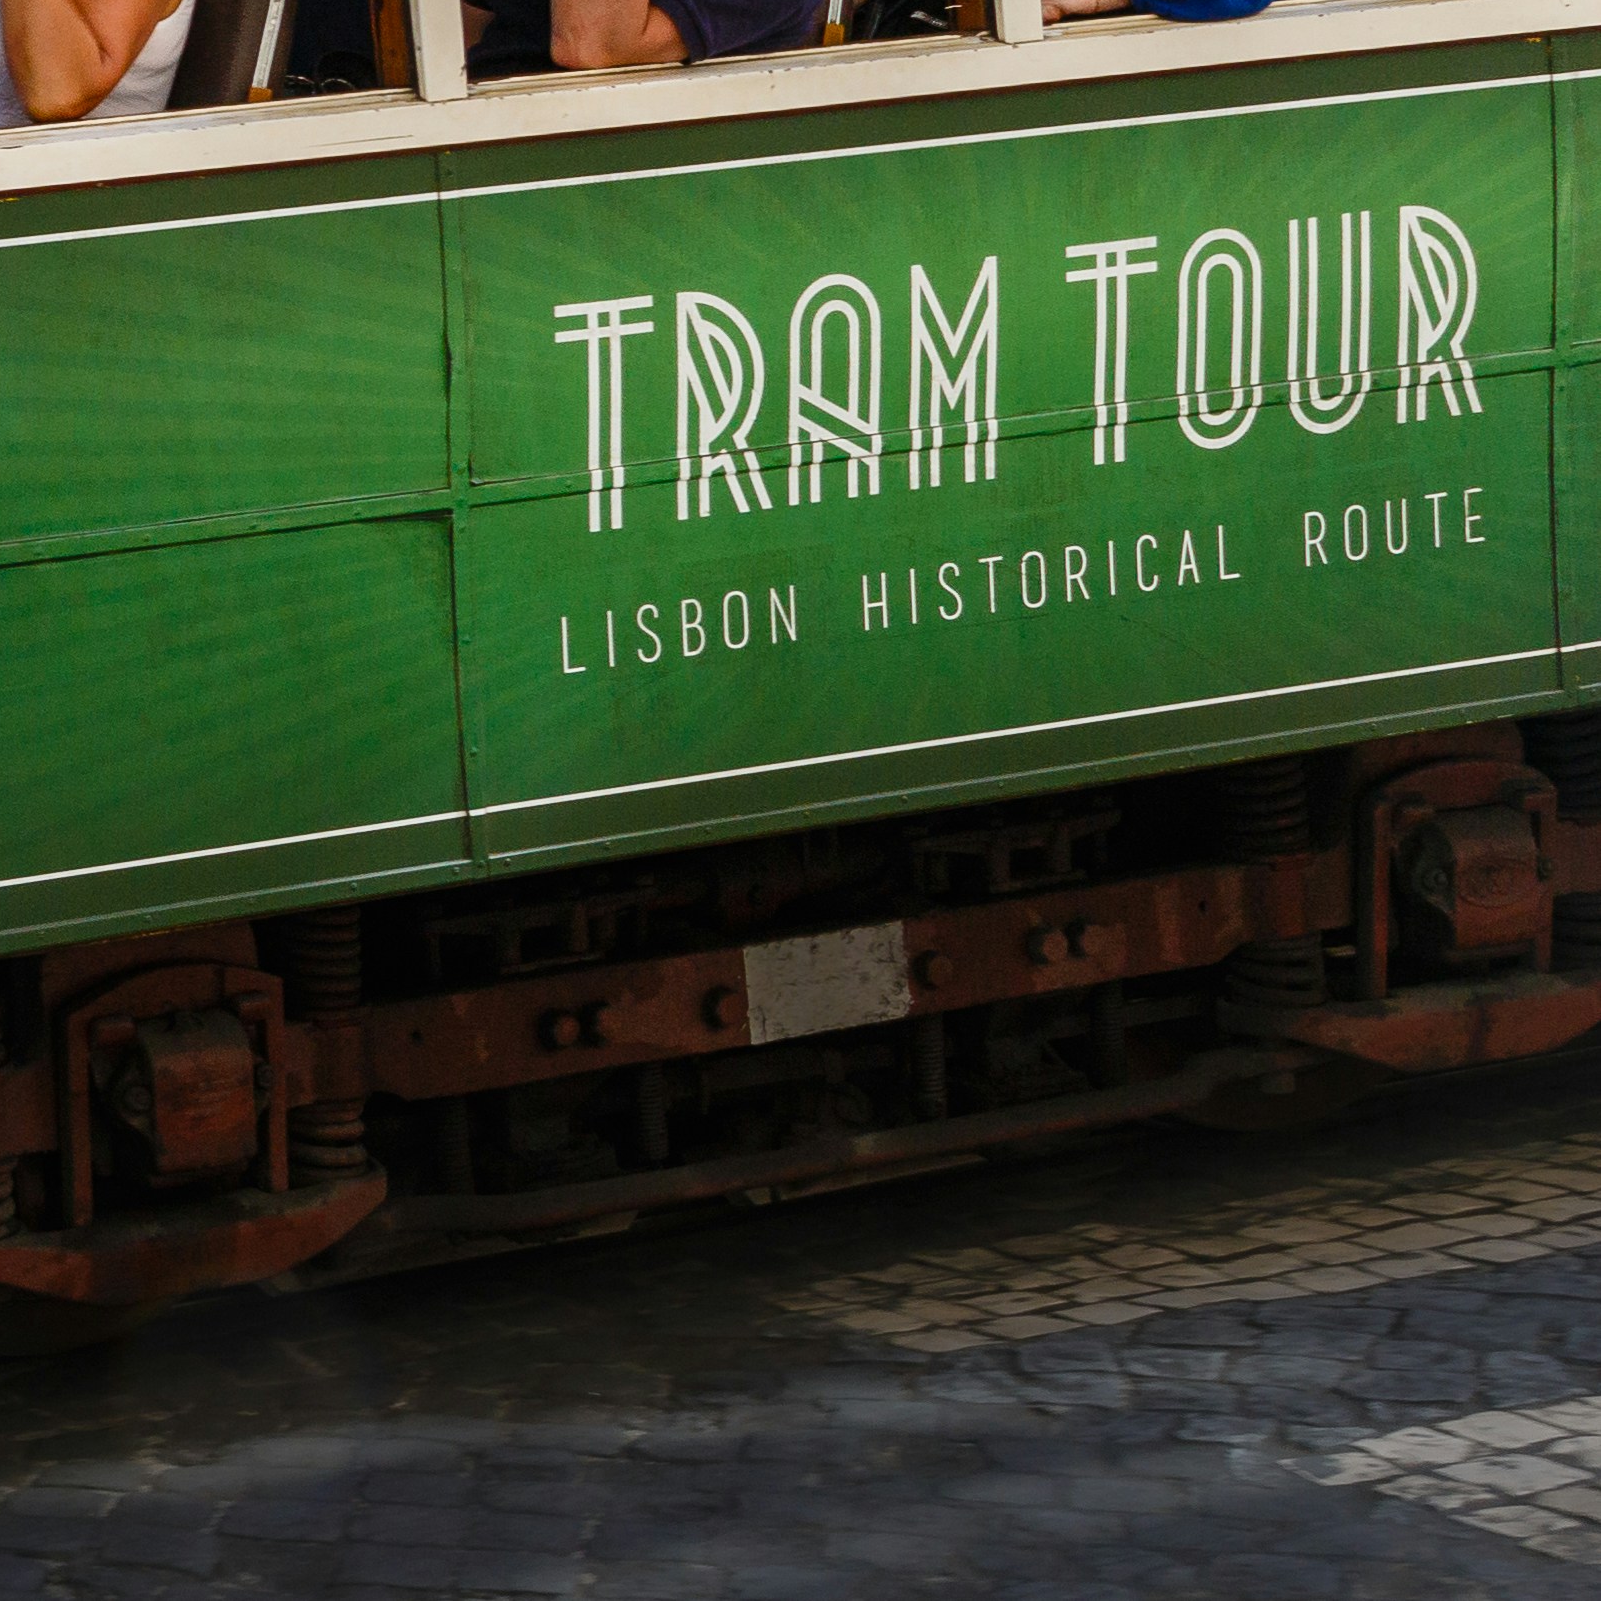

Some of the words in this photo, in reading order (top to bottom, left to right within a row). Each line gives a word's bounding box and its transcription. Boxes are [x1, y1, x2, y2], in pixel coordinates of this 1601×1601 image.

[553, 255, 999, 533] TRAM
[1064, 204, 1484, 466] TOUR
[560, 584, 798, 674] LISBON
[862, 524, 1241, 631] HISTORICAL
[1304, 487, 1486, 567] ROUTE
